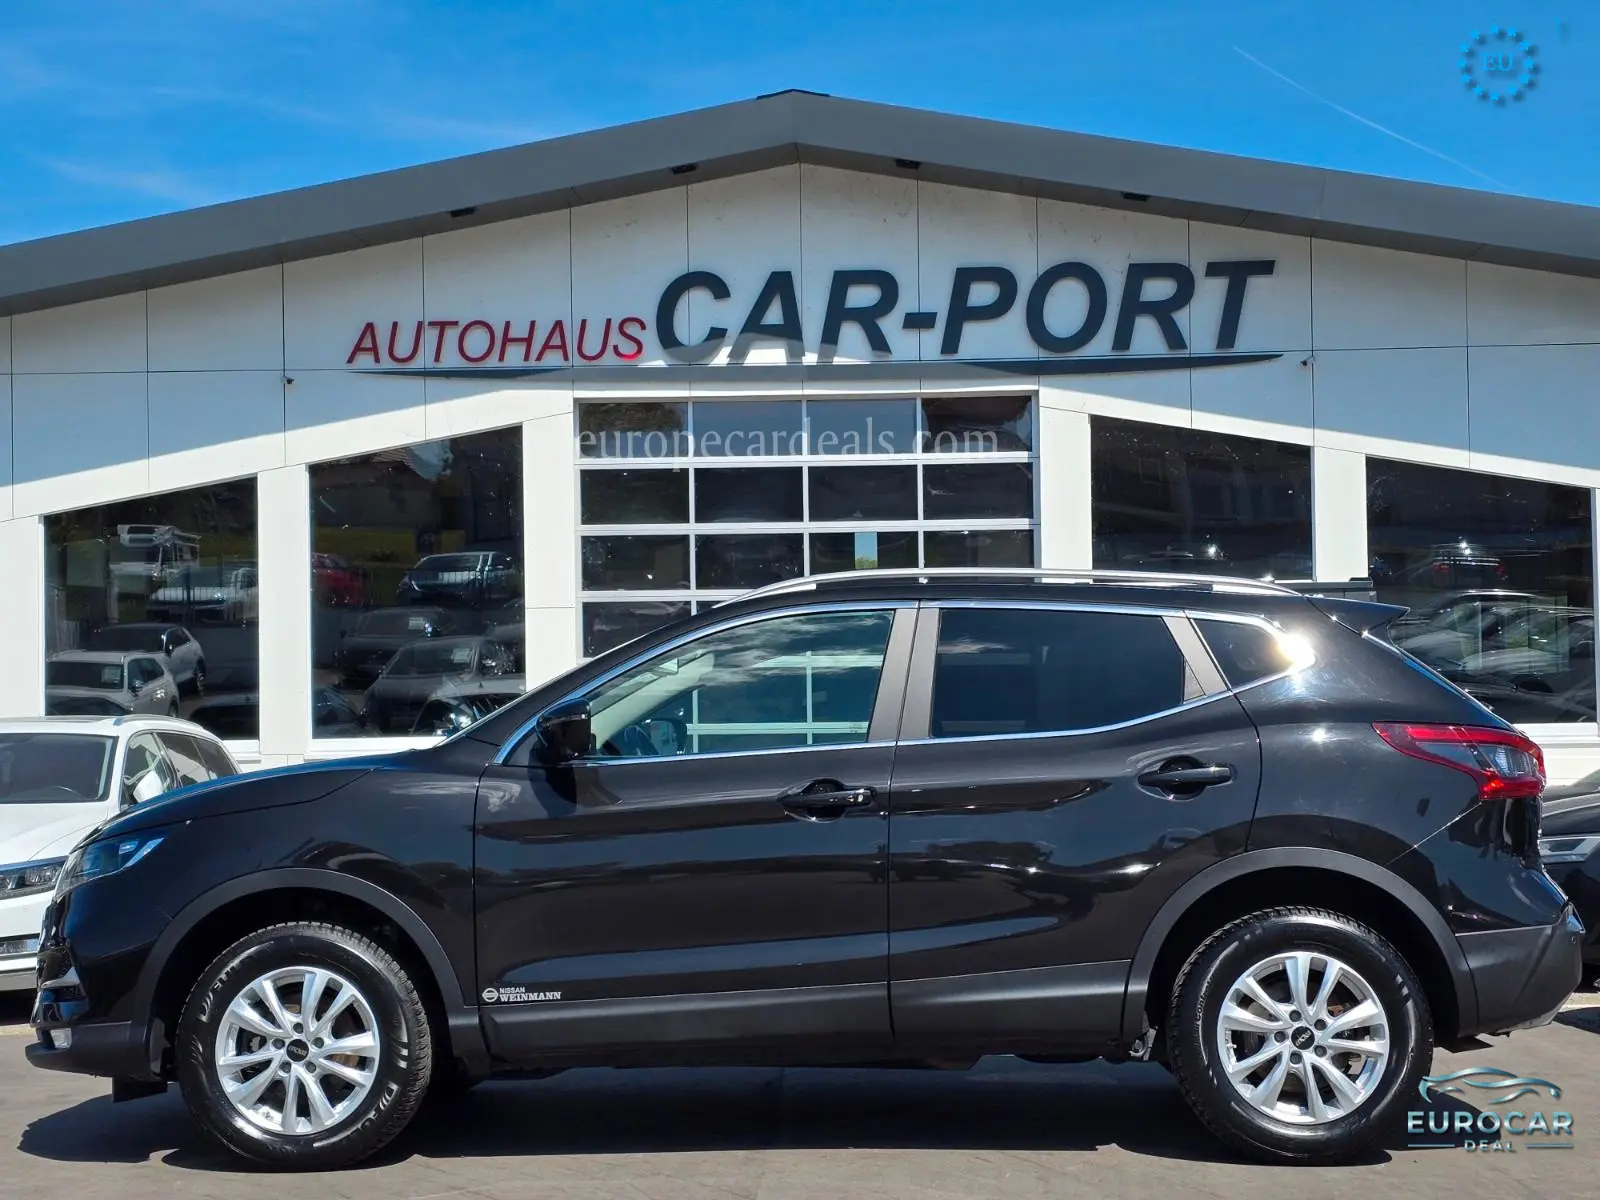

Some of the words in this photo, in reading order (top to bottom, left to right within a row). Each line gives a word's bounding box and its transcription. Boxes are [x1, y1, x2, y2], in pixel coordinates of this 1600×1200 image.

[346, 317, 646, 363] AUTOHAUS
[656, 260, 1276, 363] CAR-PORT
[499, 992, 562, 1002] WEINMANN
